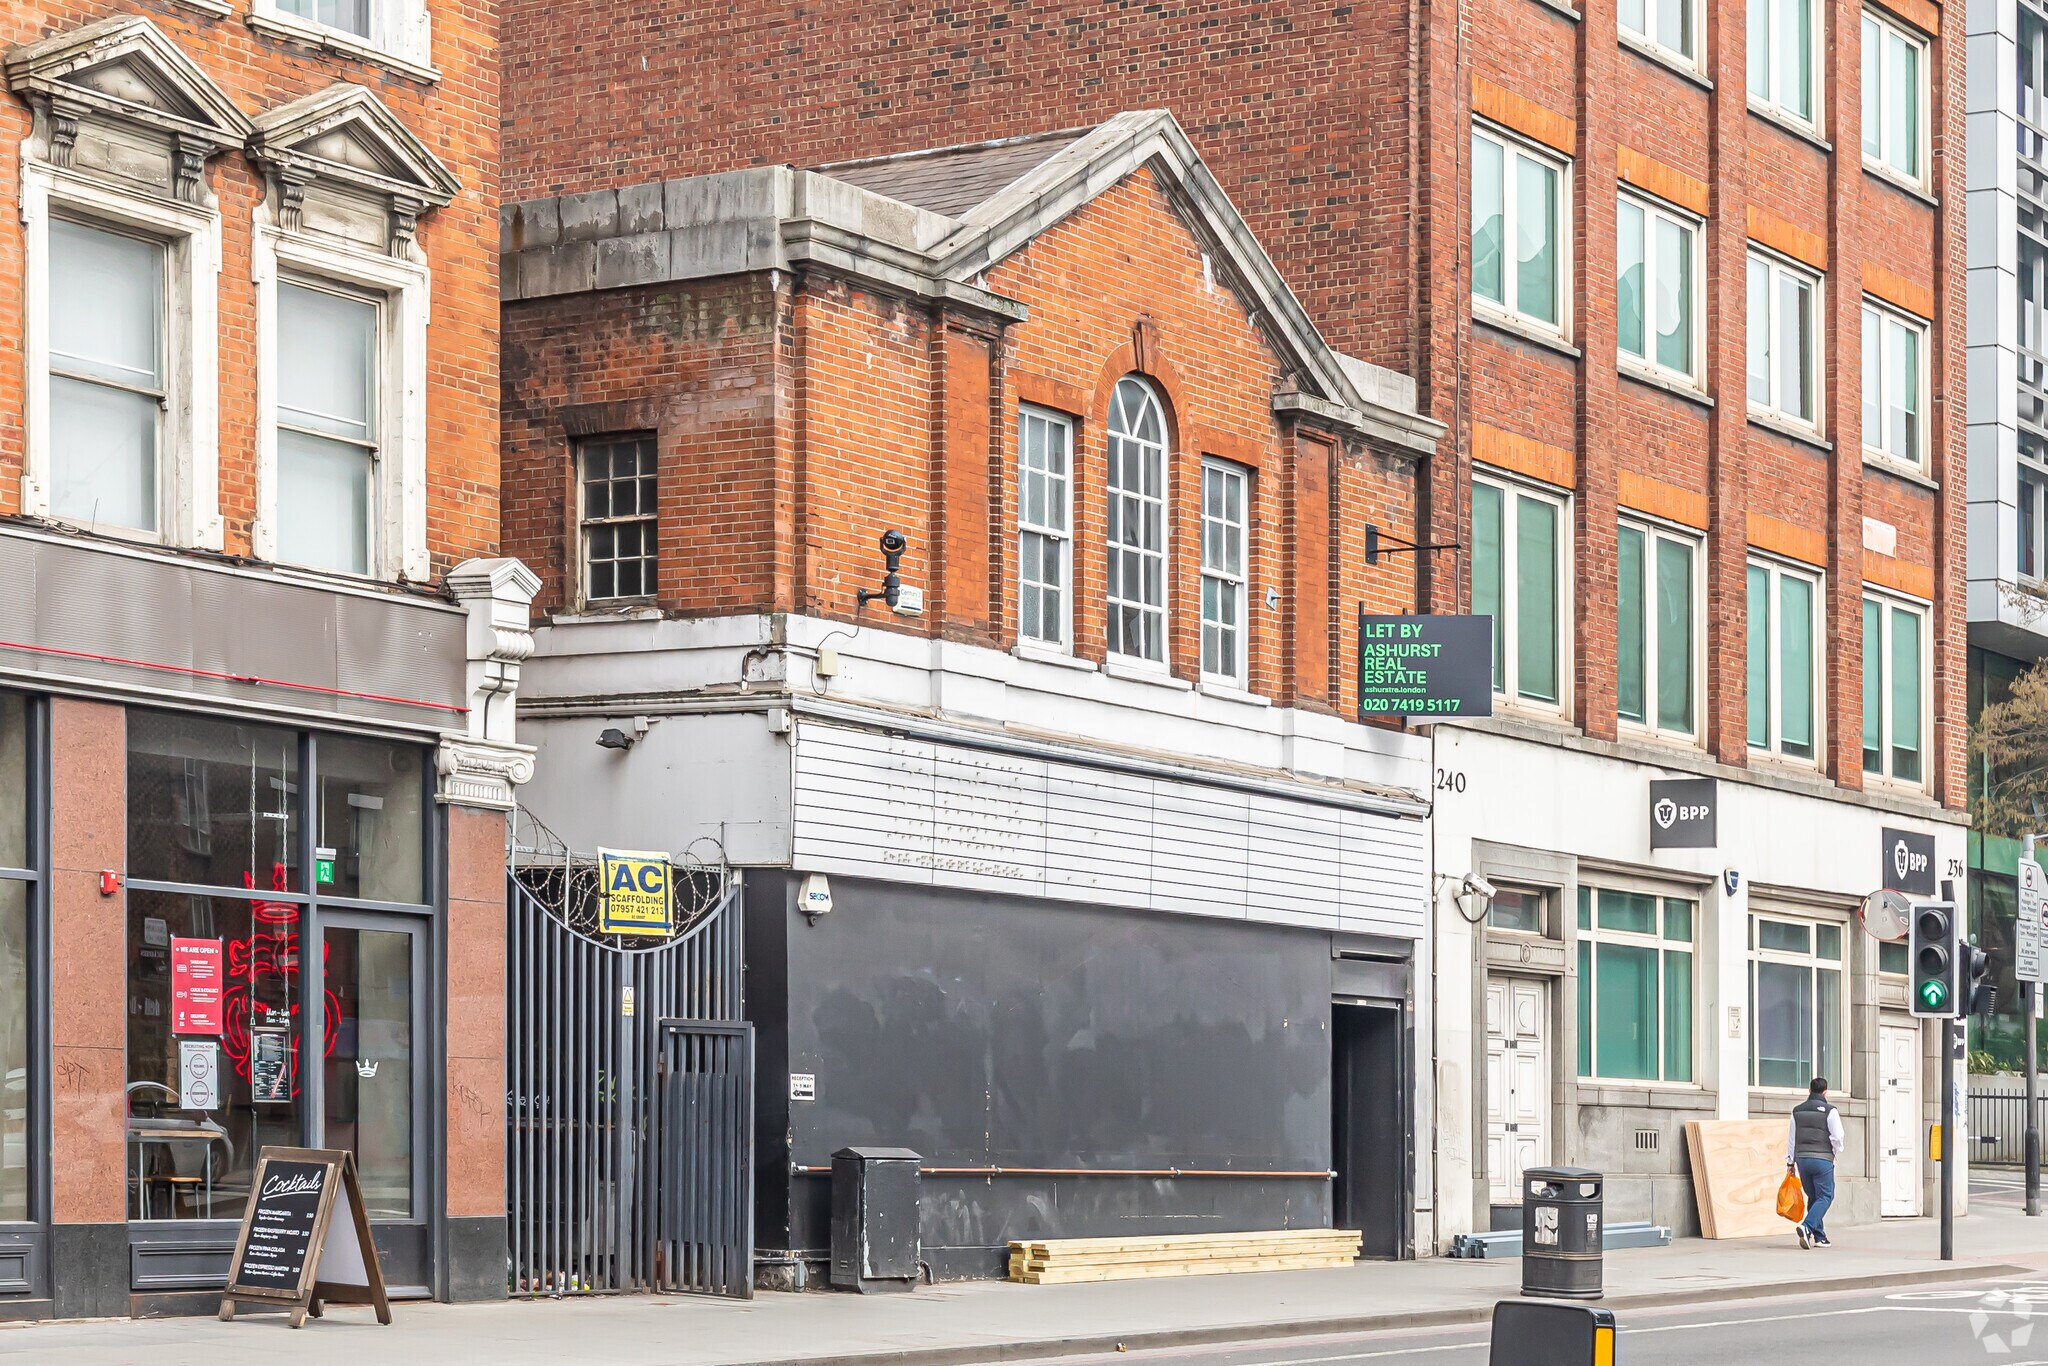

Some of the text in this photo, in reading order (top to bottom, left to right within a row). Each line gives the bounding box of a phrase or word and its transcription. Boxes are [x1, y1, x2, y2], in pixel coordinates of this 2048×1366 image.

[1366, 624, 1423, 638] LET BY
[1364, 644, 1441, 657] ASHURST
[1365, 658, 1406, 670] REAL
[1364, 671, 1426, 684] ESTATE
[1364, 698, 1460, 712] 020 7419 5117
[1436, 768, 1466, 793] 240
[1680, 805, 1710, 821] BPP
[1909, 852, 1928, 872] BPP
[1948, 858, 1963, 877] 236
[612, 864, 662, 893] AC
[611, 894, 663, 904] SCAFFOLDING
[611, 904, 634, 913] 07957
[263, 1170, 321, 1195] Cocktails
